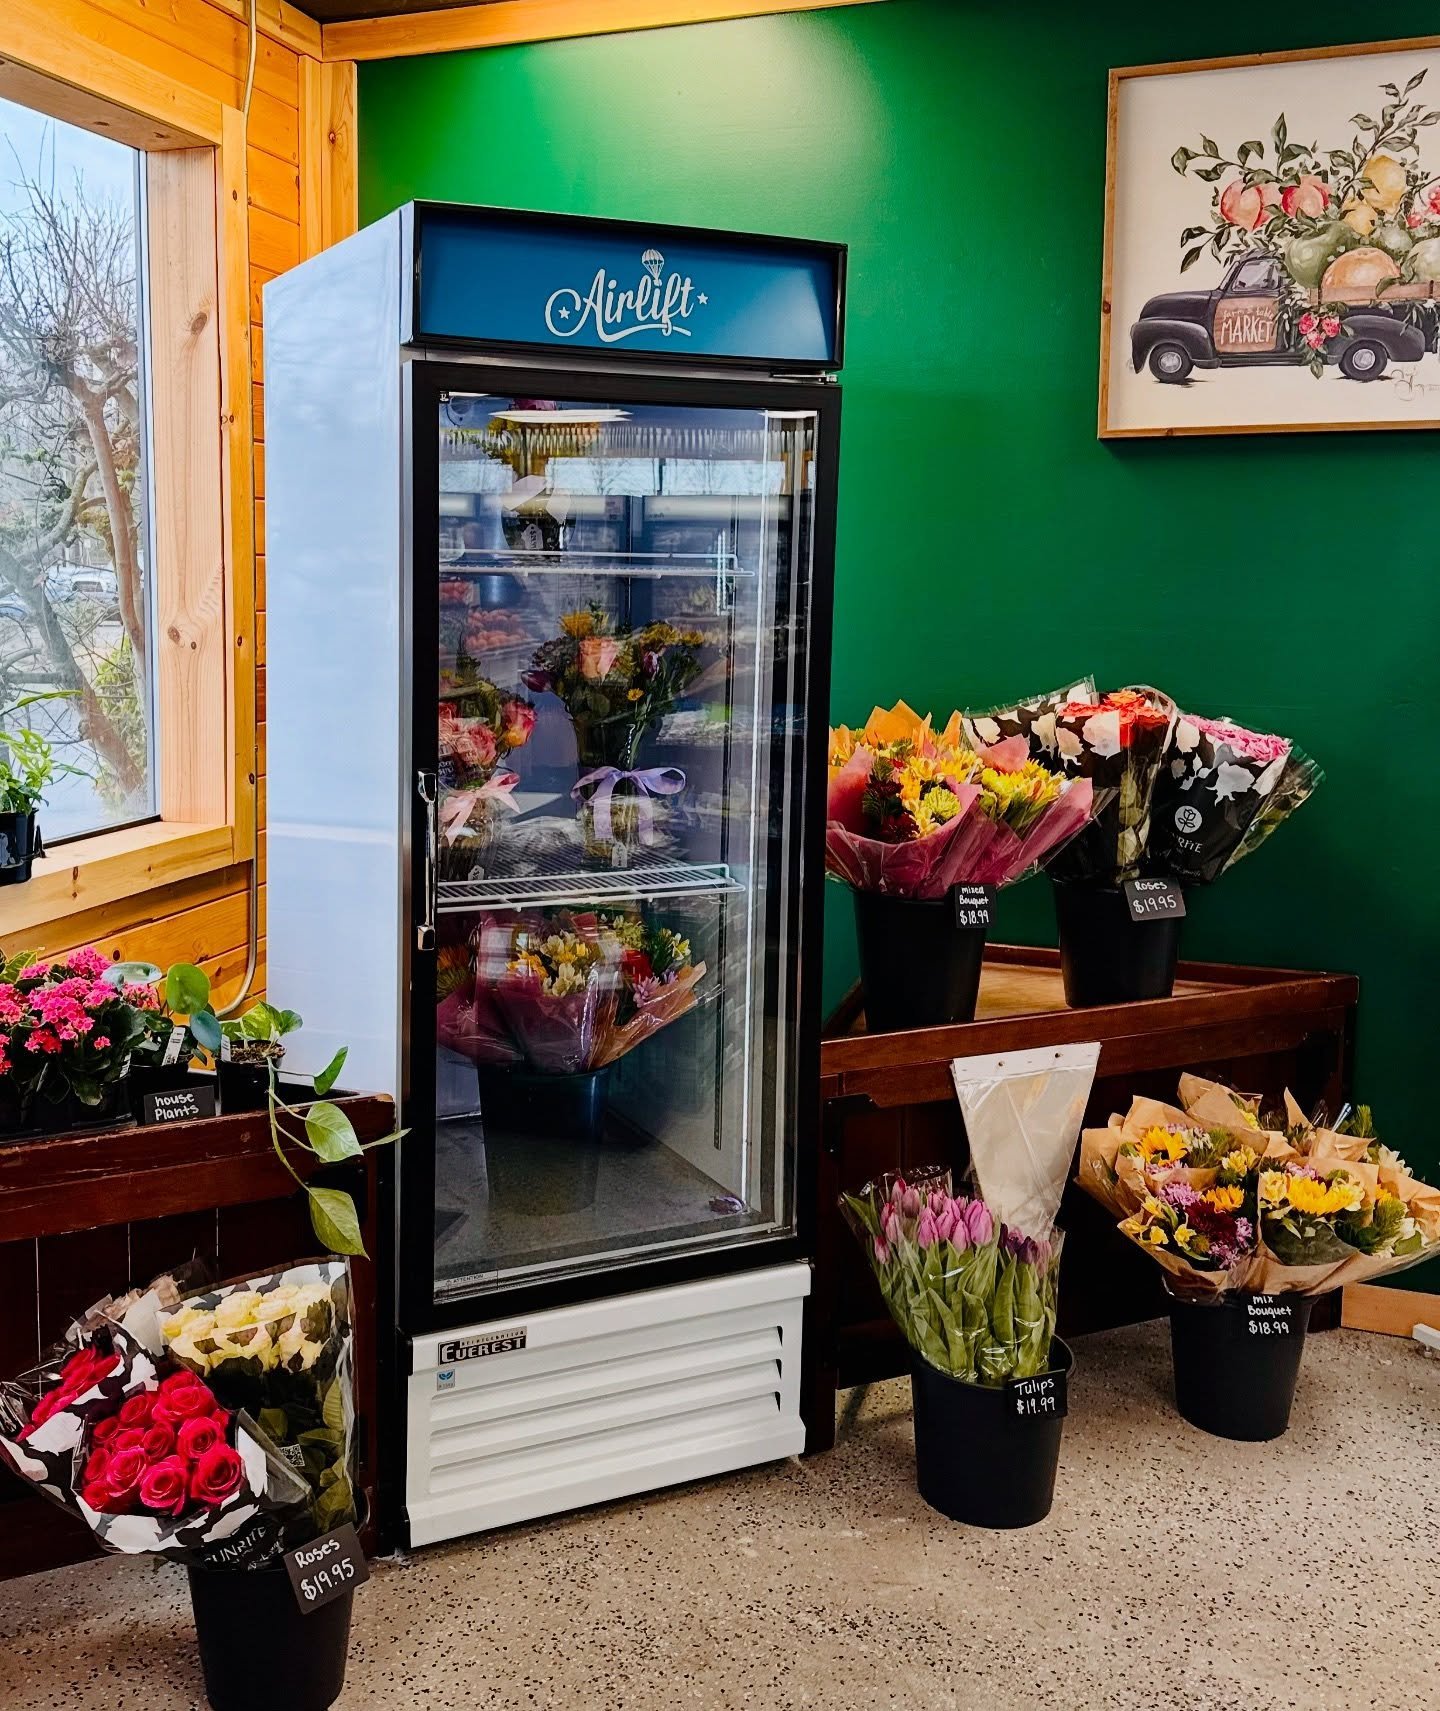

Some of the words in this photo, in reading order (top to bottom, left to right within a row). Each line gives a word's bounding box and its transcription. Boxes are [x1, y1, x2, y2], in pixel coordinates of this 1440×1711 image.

[545, 268, 695, 343] Airlift
[1220, 314, 1273, 345] MARKET
[1134, 881, 1168, 891] Roses
[959, 894, 989, 908] Bouquet
[1132, 894, 1177, 914] $19.95
[959, 909, 989, 925] $18.99
[154, 1092, 195, 1107] house
[154, 1104, 199, 1121] Plants
[1247, 1304, 1292, 1319] Bouquet
[1248, 1320, 1290, 1335] $18.99
[441, 1336, 523, 1363] EVEREST
[1014, 1379, 1055, 1396] Tulips
[1016, 1397, 1056, 1415] $19.99
[294, 1539, 341, 1569] Roses
[300, 1557, 355, 1601] $19.95
